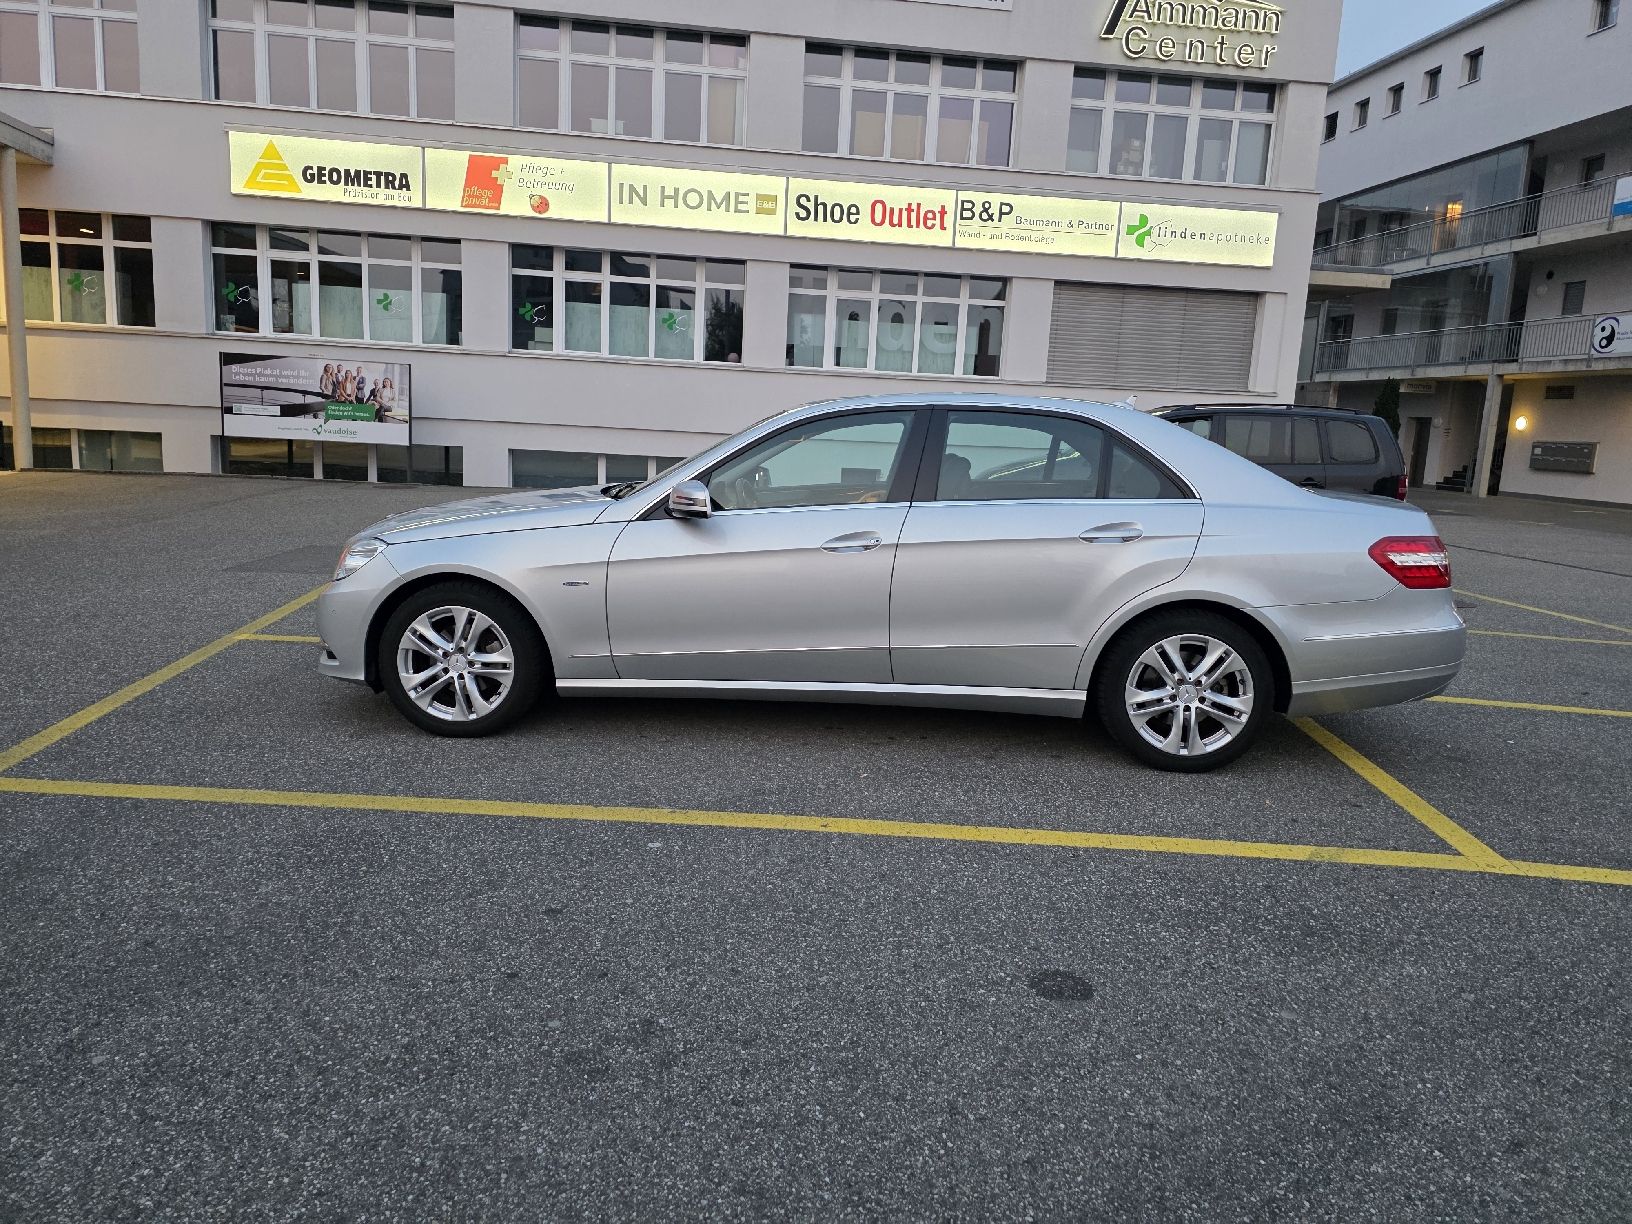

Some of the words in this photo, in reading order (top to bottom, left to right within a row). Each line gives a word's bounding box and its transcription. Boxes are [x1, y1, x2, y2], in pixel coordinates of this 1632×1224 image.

[1127, 0, 1281, 33] Ammann
[1122, 25, 1277, 68] Center
[302, 165, 411, 191] GEOMETRA
[463, 195, 489, 206] privat
[465, 186, 493, 198] pflege
[617, 182, 648, 207] IN
[659, 185, 750, 213] HOME
[794, 193, 860, 225] Shoe
[869, 199, 947, 231] Outlet
[959, 199, 1014, 223] B&P
[1015, 216, 1063, 228] Baumann
[1077, 220, 1115, 231] Partner
[1157, 226, 1270, 245] lindenapotheke
[232, 366, 256, 374] Dieses
[256, 367, 280, 375] Plakat
[281, 369, 298, 377] wird
[232, 374, 253, 382] Leben
